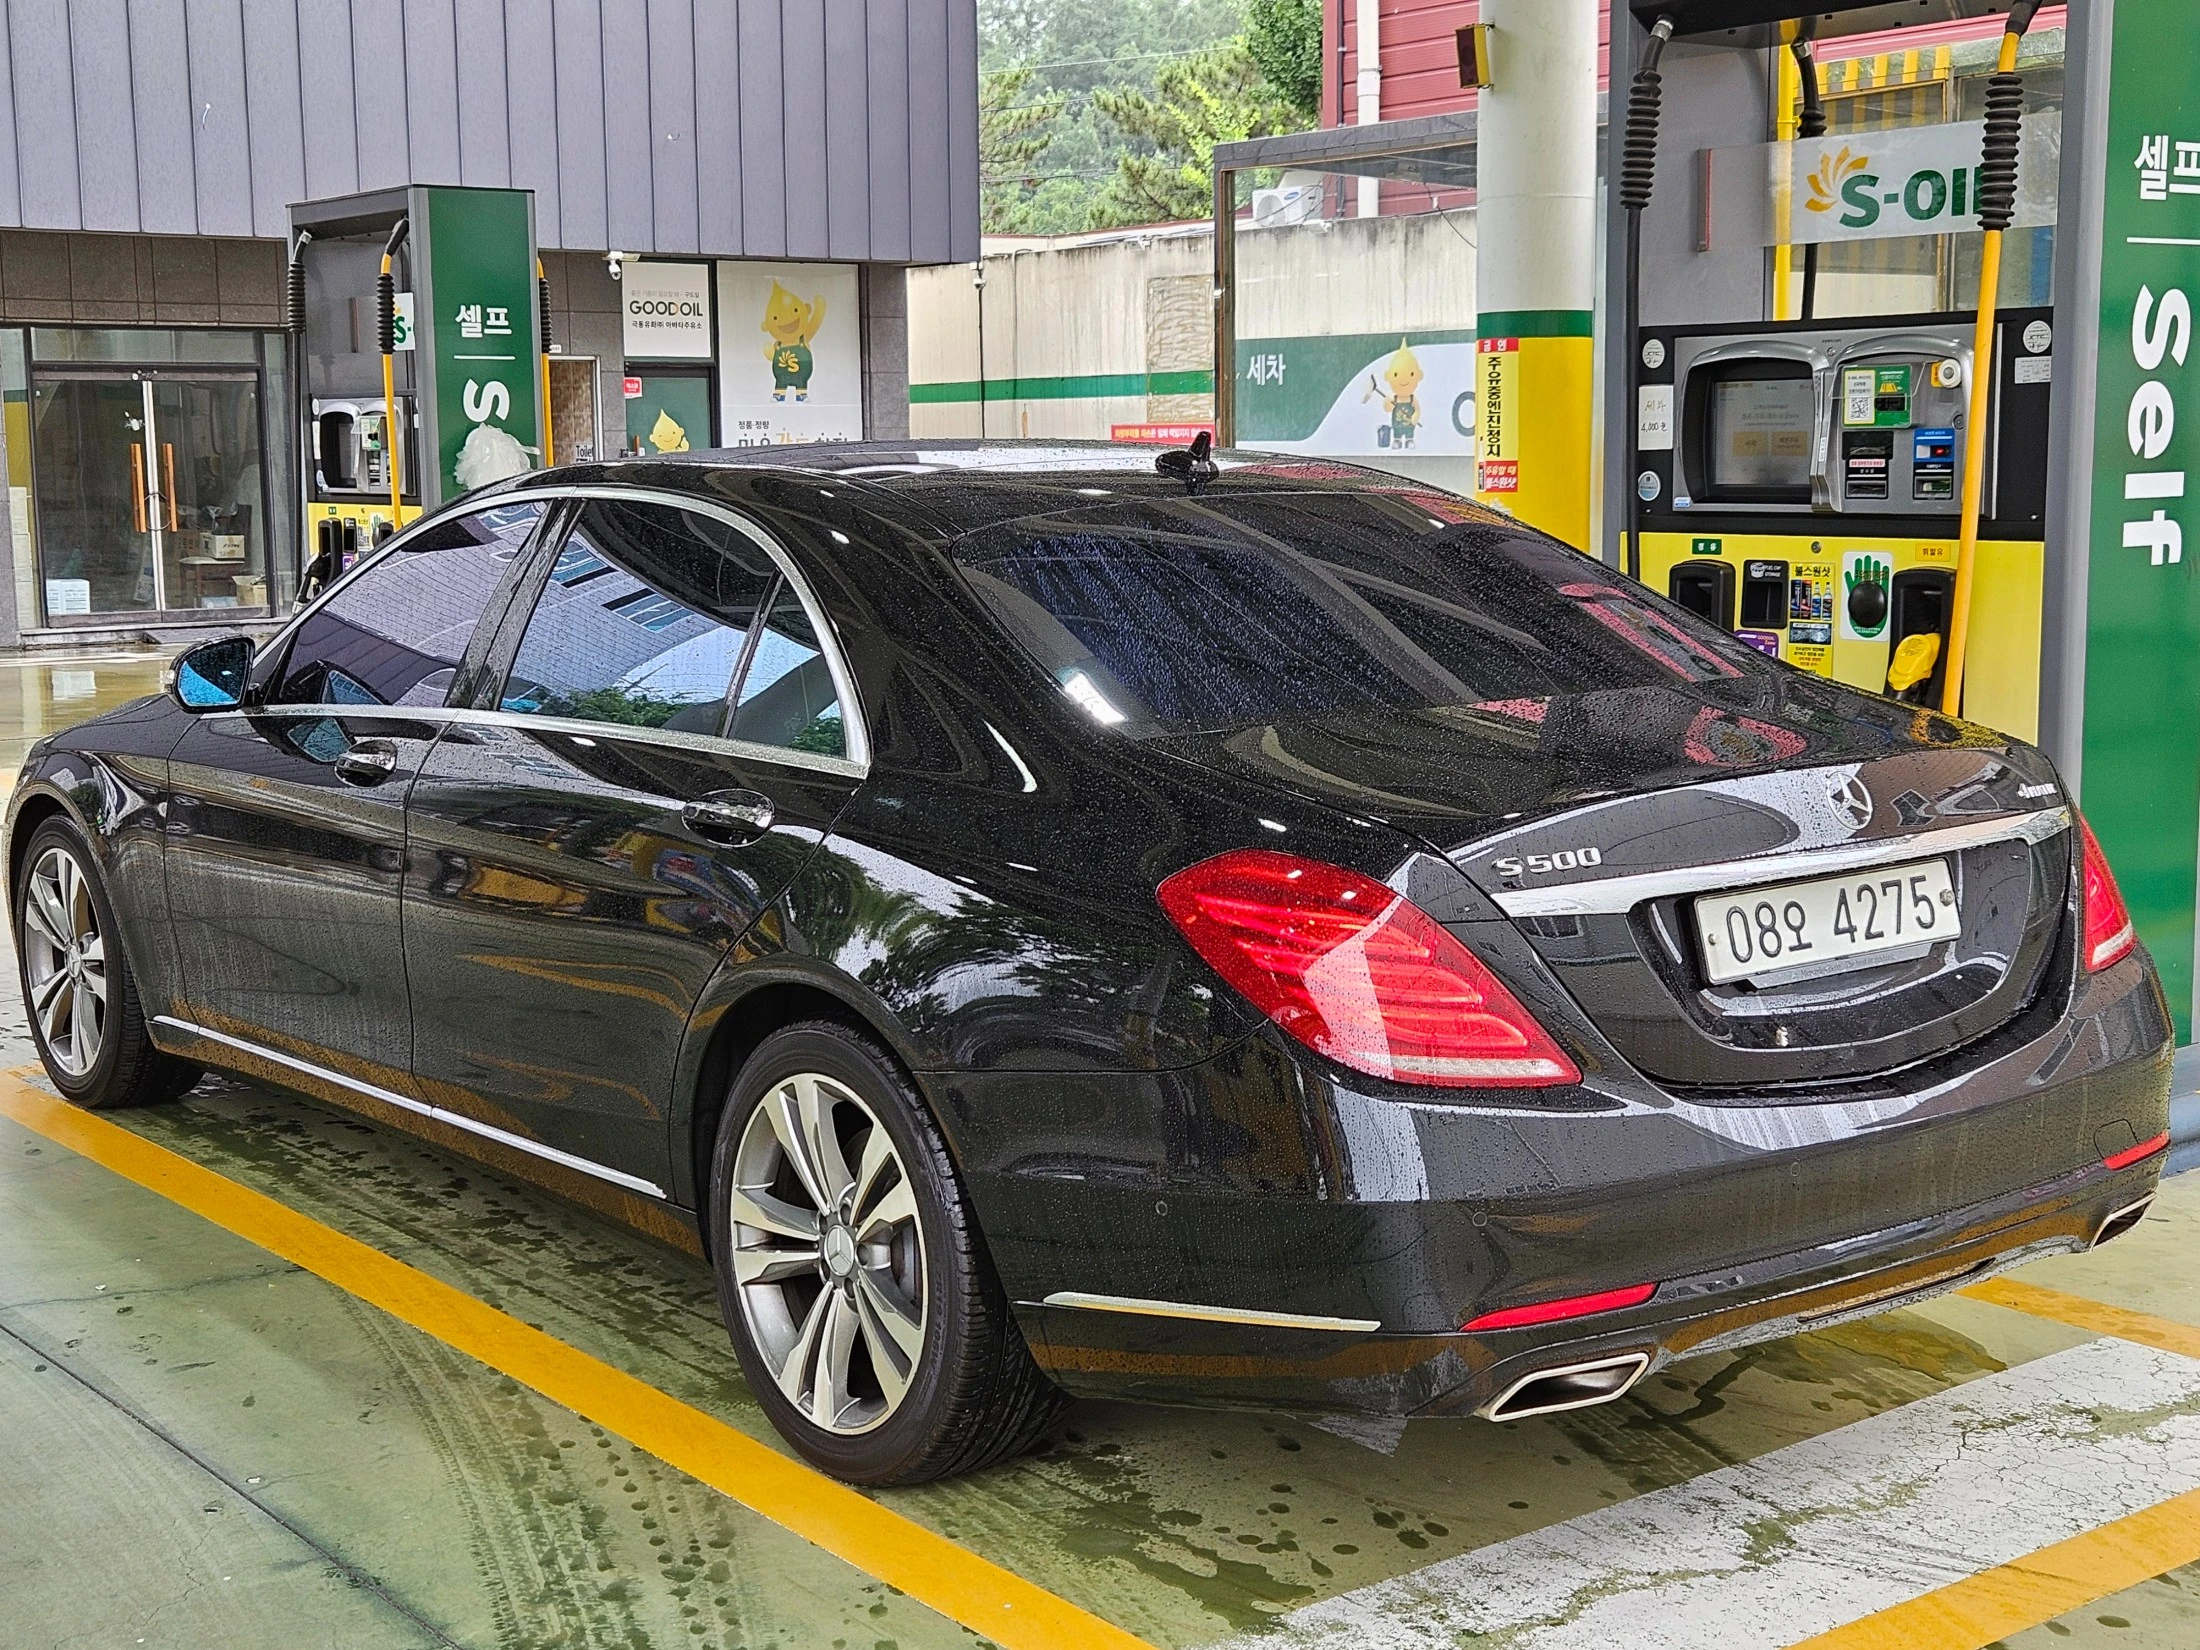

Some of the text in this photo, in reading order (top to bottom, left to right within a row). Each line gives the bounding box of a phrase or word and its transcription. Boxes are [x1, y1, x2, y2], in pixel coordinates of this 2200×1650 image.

[2134, 134, 2200, 200] 셀프
[455, 304, 512, 338] 셀프
[1246, 353, 1286, 386] 세차
[1486, 356, 1502, 458] 주유중엔진정지
[2122, 284, 2191, 567] Self
[1795, 565, 1831, 578] 불스원샷
[1496, 847, 1603, 877] S 500
[1726, 875, 1936, 964] 08오 4275
